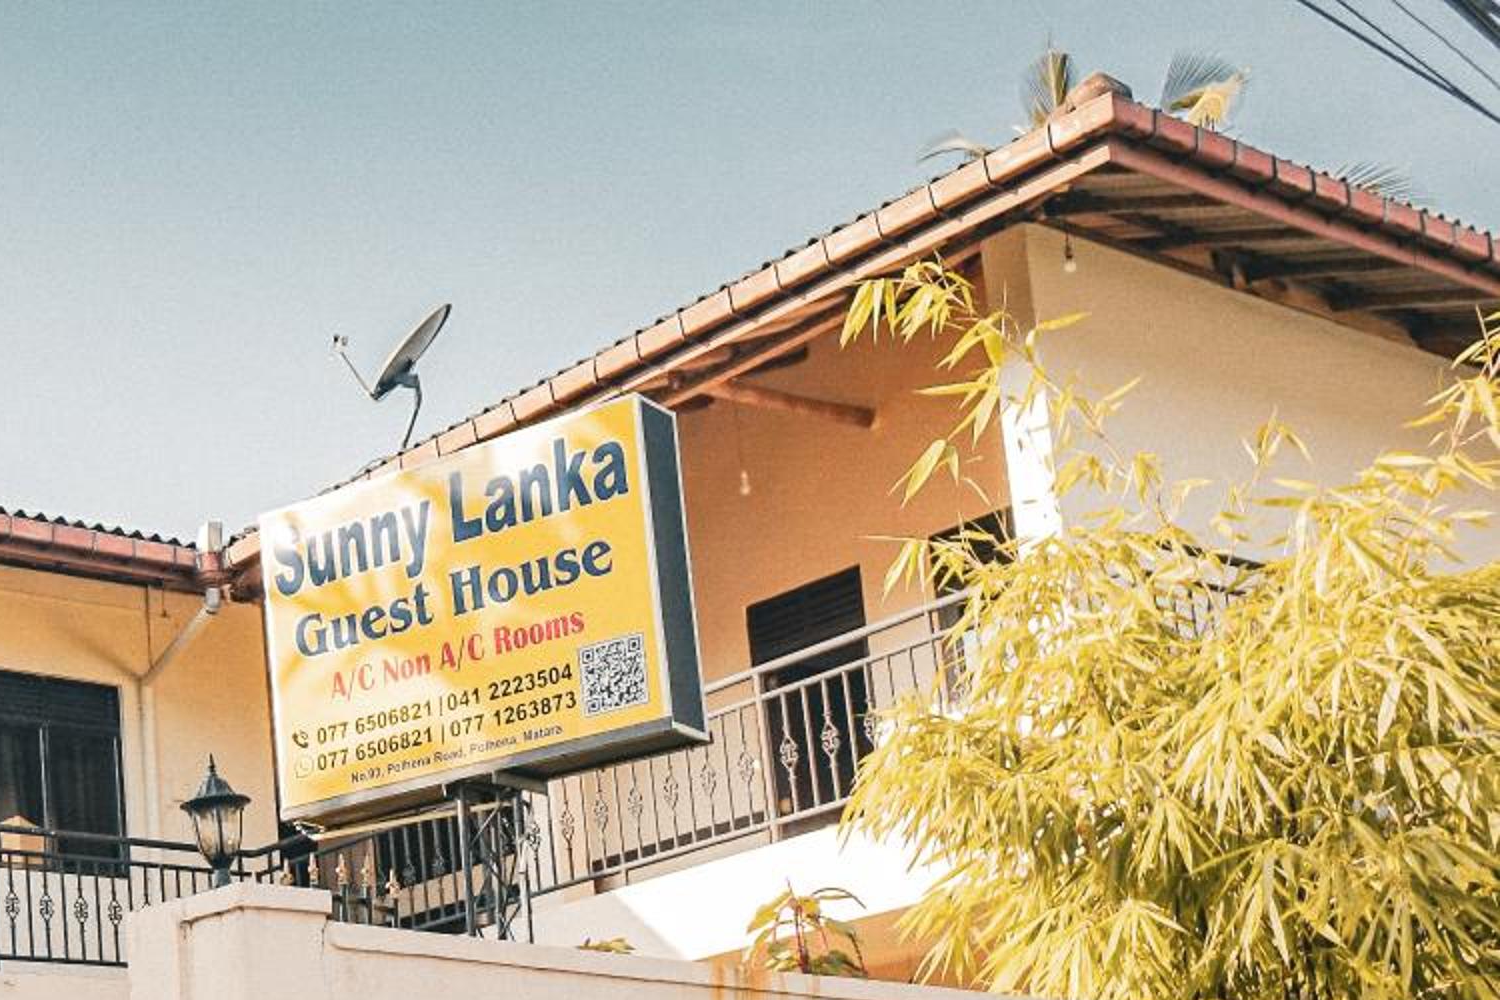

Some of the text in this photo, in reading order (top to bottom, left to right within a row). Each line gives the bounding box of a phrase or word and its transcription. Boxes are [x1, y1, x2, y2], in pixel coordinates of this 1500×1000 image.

[274, 437, 629, 597] Sunny Lanka
[295, 539, 613, 658] Guest House
[331, 611, 585, 701] A/C Non A/C Rooms
[317, 721, 349, 745] 077
[355, 701, 432, 738] 6506821
[488, 663, 573, 701] 2223504
[317, 748, 349, 771] 077
[355, 727, 433, 761] 6506821
[450, 713, 484, 737] 077
[494, 691, 577, 727] 1263873
